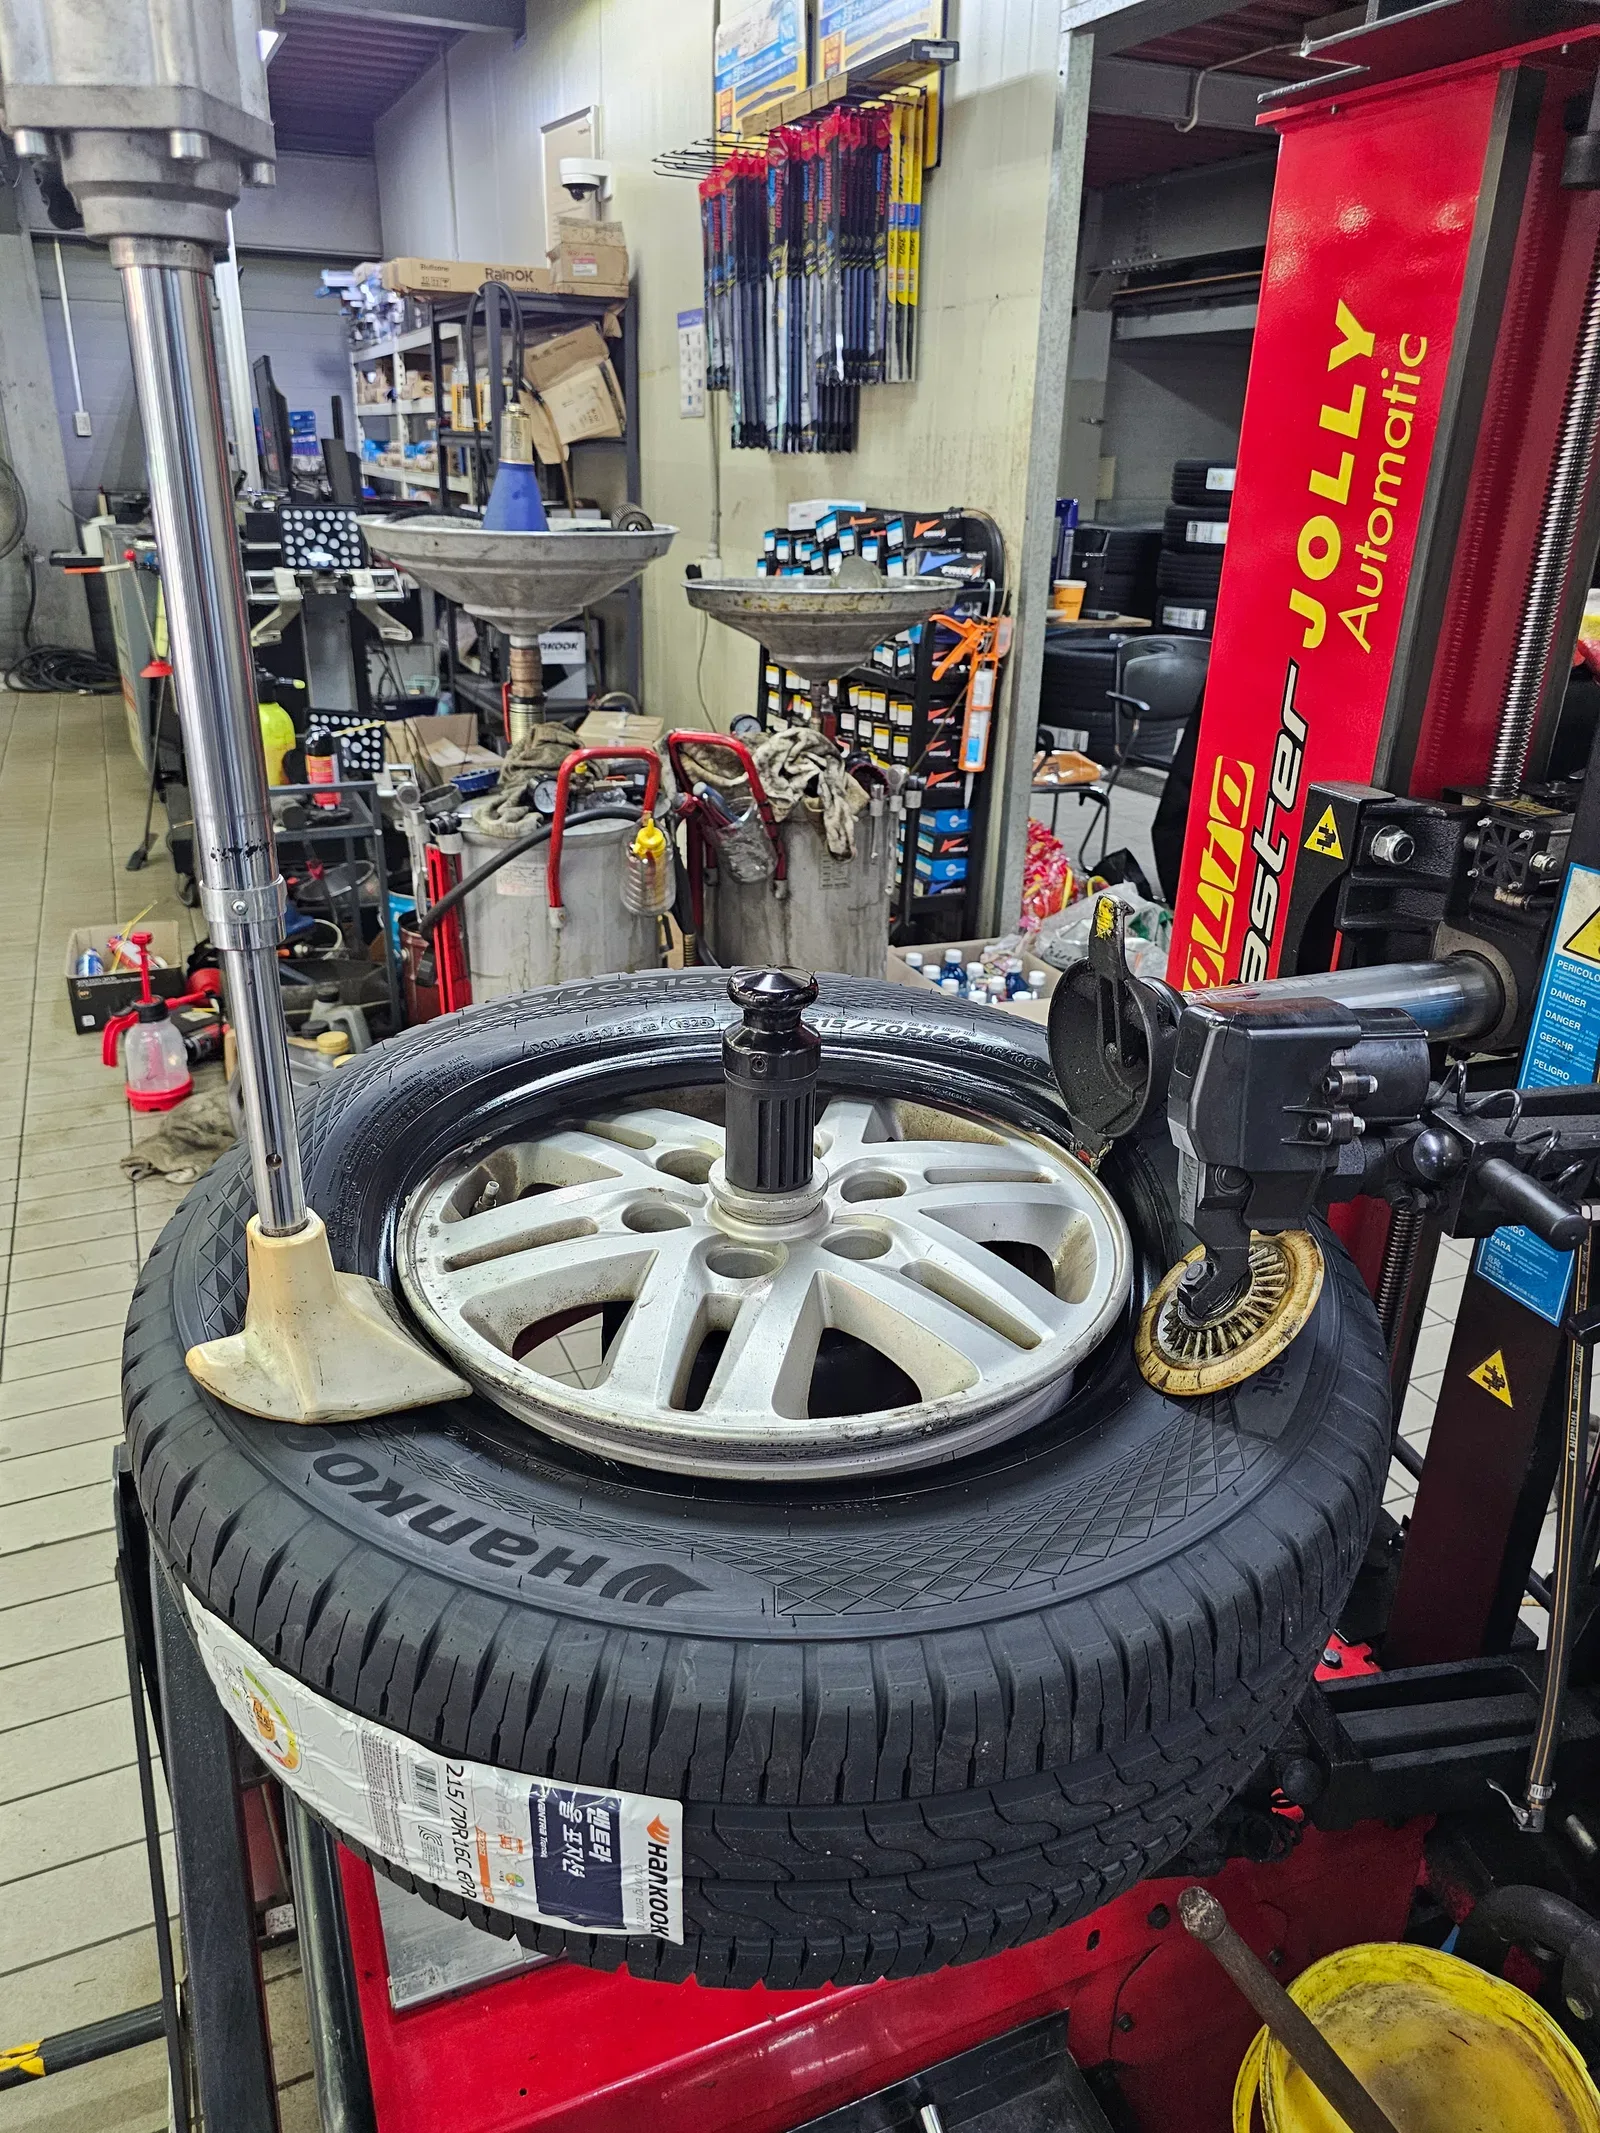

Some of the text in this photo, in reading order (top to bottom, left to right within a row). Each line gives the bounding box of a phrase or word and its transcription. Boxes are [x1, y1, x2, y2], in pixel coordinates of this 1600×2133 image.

[484, 266, 535, 284] RainOK
[1289, 299, 1376, 650] JOLLY
[1337, 332, 1427, 654] Automatic
[1234, 658, 1308, 985] aster
[1556, 958, 1600, 984] PERICOLO
[1550, 987, 1587, 1008] DANGER
[804, 1017, 971, 1047] 215/70R16C
[1545, 1009, 1581, 1031] DANGER
[1540, 1031, 1574, 1052] GEFAHR
[1533, 1058, 1570, 1081] PELIGRO
[1490, 1234, 1511, 1253] FARA
[445, 1763, 478, 1900] 215/70R16C 6PR
[559, 1800, 586, 1879] 올 포지션
[586, 1806, 612, 1864] 밴트라
